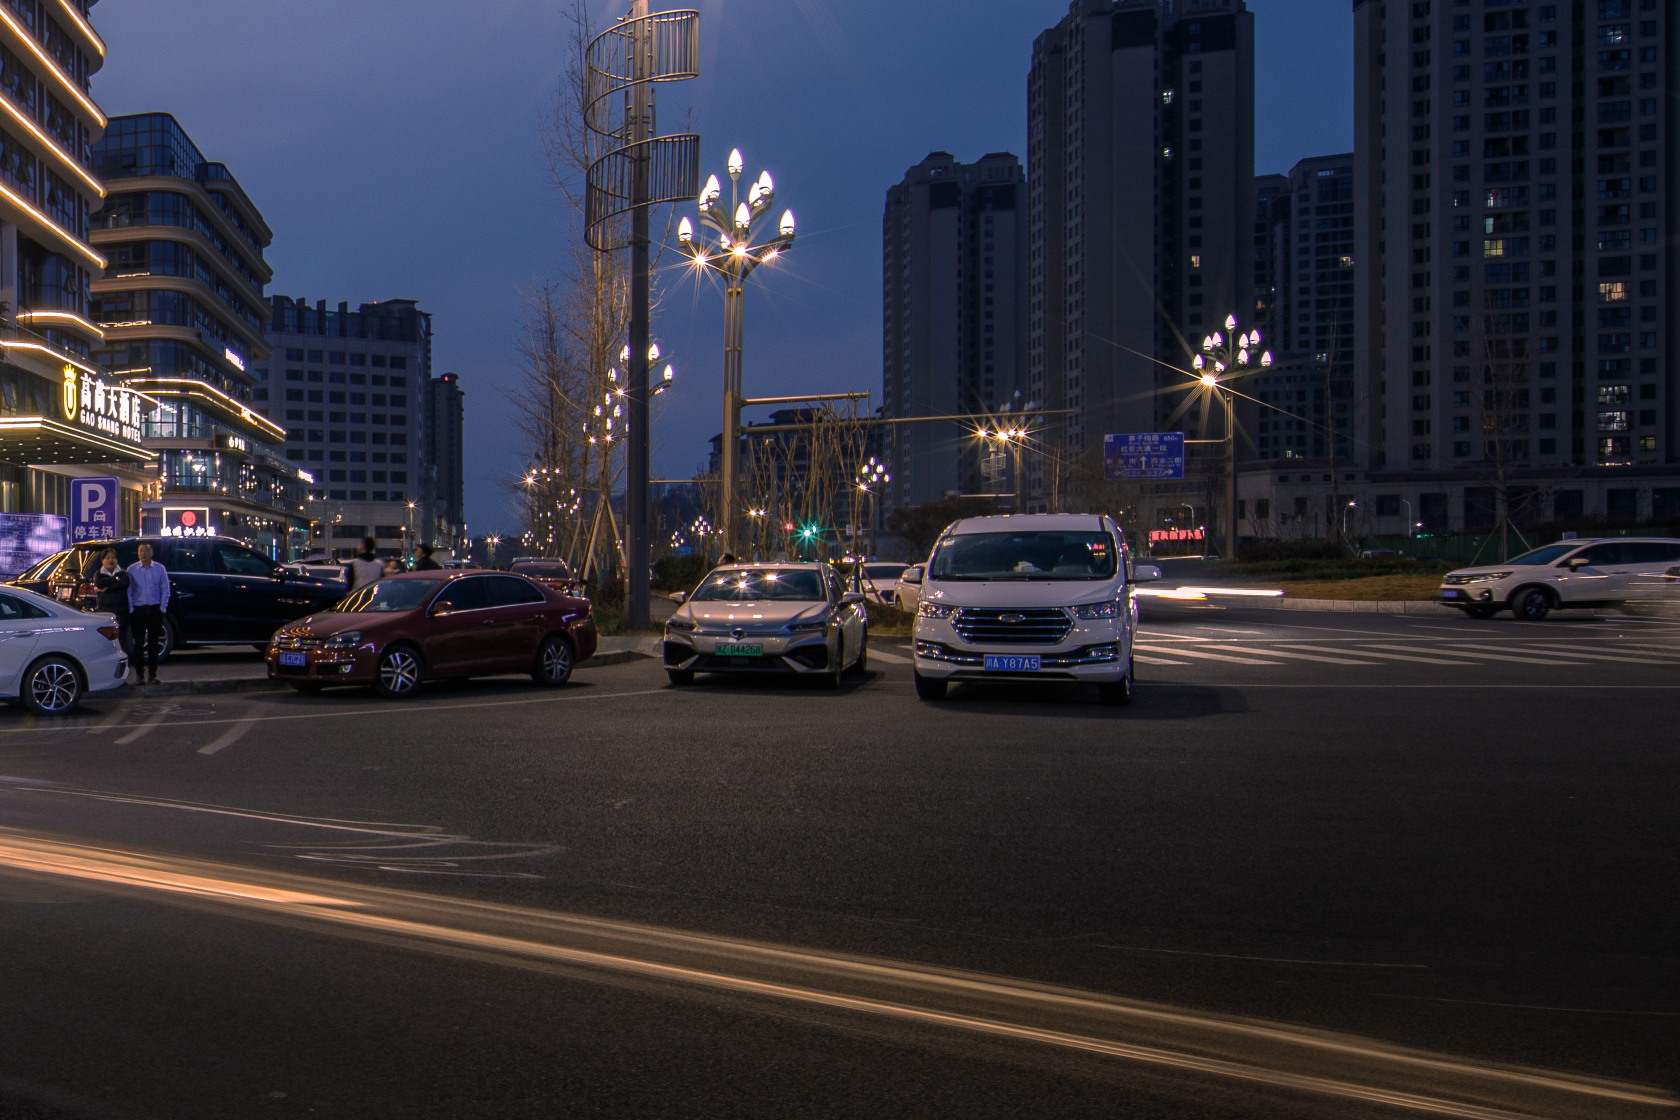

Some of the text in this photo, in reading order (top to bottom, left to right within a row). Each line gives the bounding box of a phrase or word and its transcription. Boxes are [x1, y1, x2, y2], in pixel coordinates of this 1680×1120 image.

[80, 372, 141, 429] 高尚大酒店
[80, 409, 142, 443] GAO SHANG HOTEL
[81, 483, 107, 523] P
[74, 525, 114, 539] 停车场
